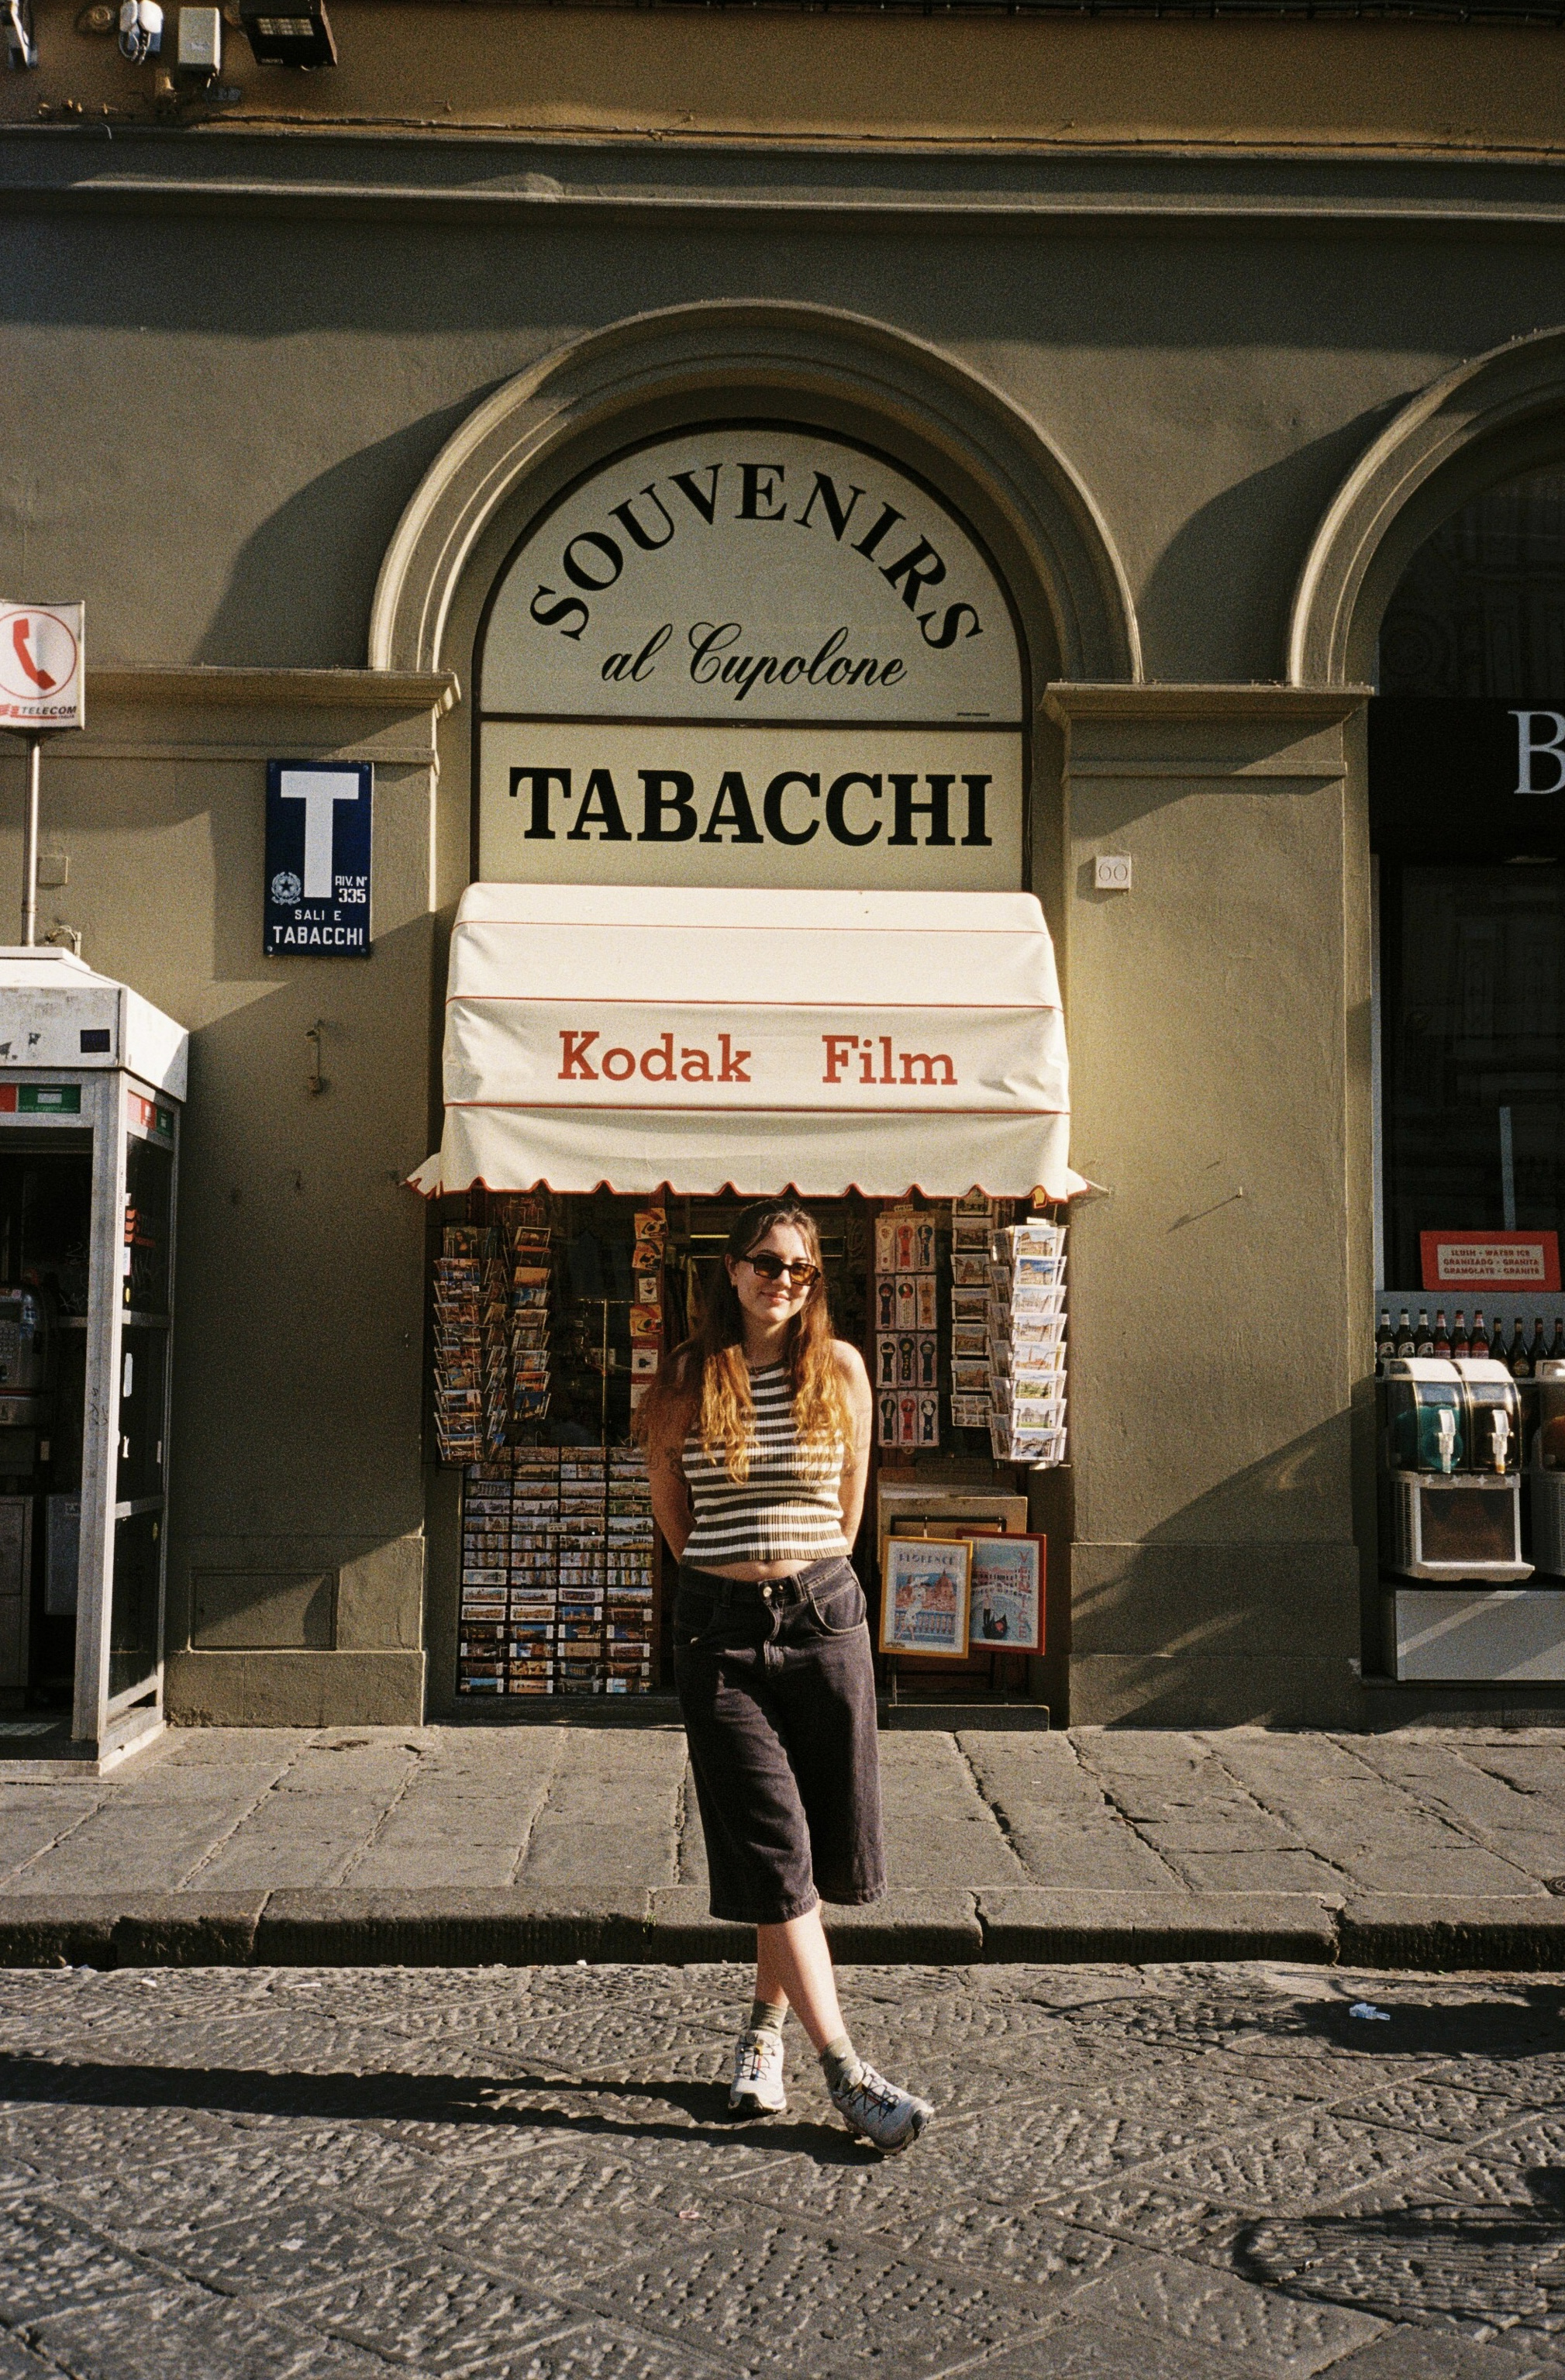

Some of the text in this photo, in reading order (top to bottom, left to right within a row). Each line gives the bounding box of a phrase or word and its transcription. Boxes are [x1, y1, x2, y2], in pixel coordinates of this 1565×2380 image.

[529, 463, 983, 650] SOUVENIRS
[602, 622, 907, 701] al Cupolone
[22, 705, 77, 715] TELECOM
[509, 767, 992, 847] TABACCHI
[281, 771, 360, 898] T
[335, 875, 353, 886] RIV.
[338, 888, 367, 904] 335
[295, 909, 342, 921] SALI E
[273, 926, 363, 945] TABACCHI
[559, 1031, 957, 1085] Kodak Film
[899, 1553, 955, 1565] FLORENCE
[1018, 1551, 1031, 1639] VENICE
